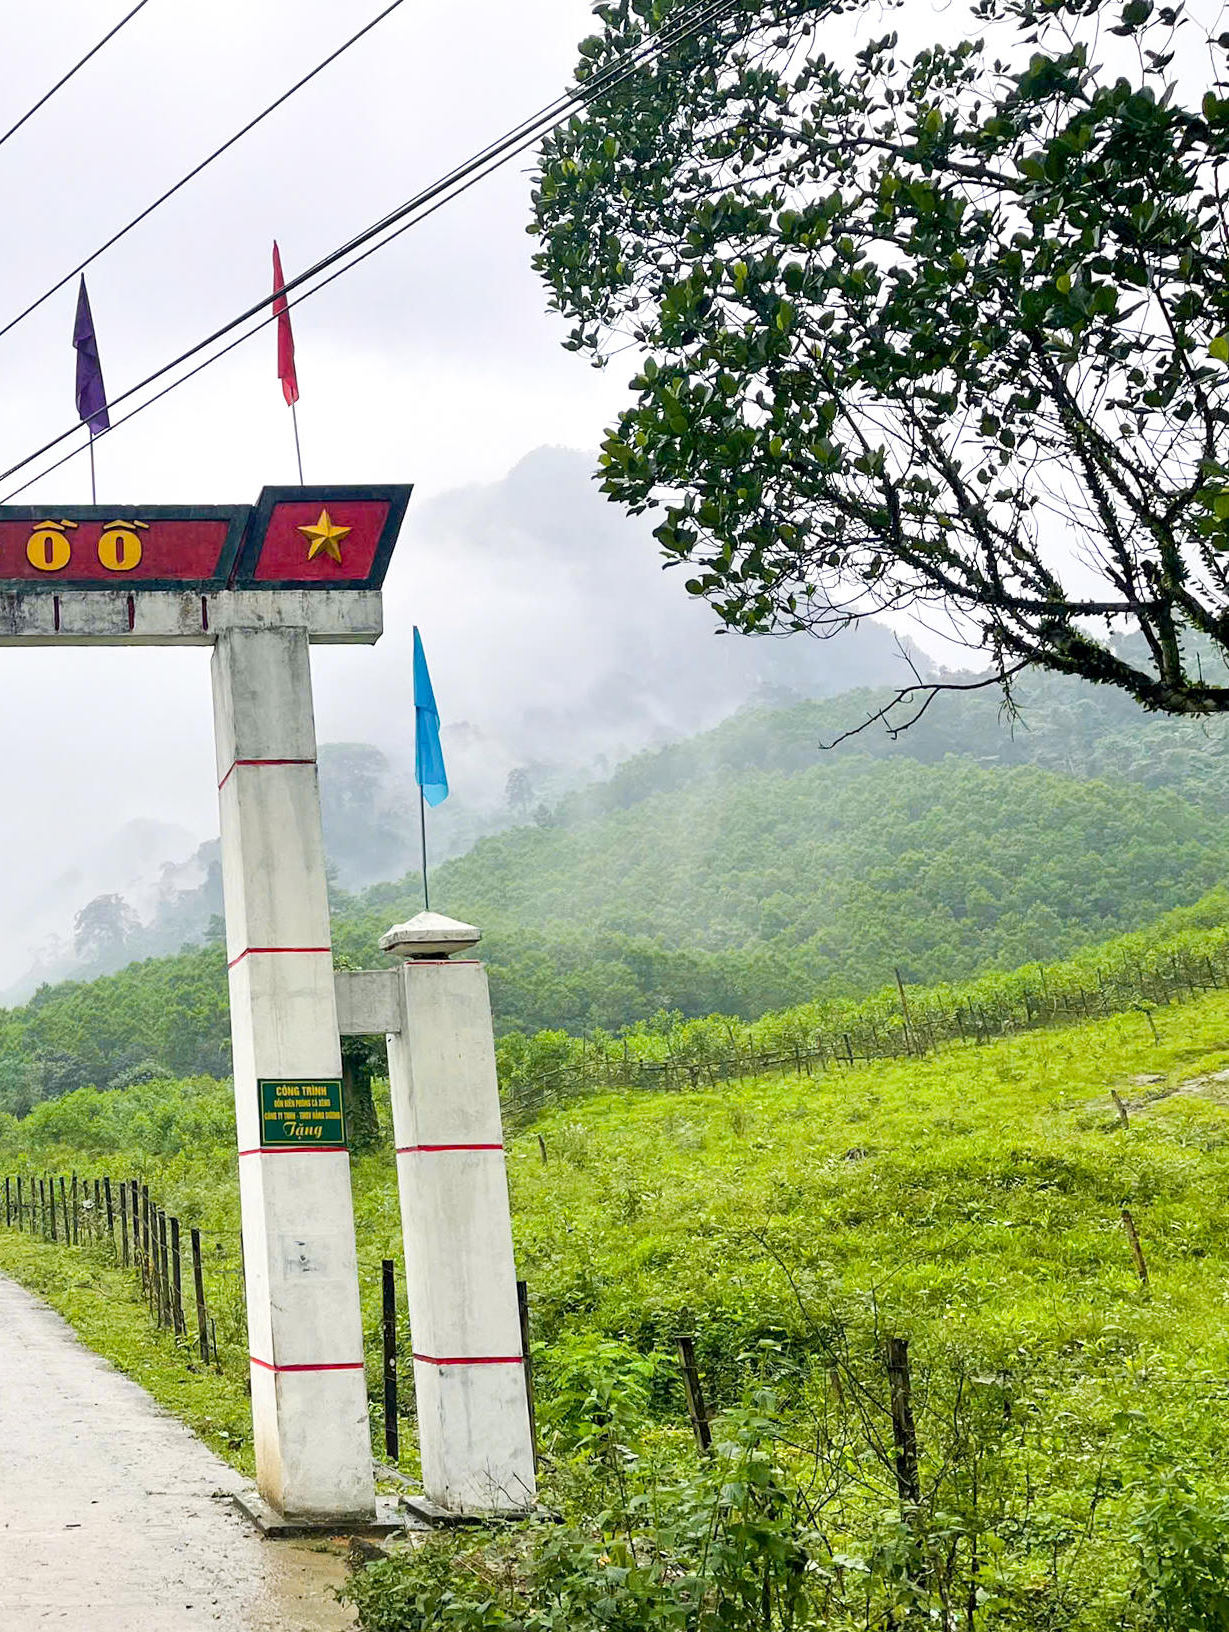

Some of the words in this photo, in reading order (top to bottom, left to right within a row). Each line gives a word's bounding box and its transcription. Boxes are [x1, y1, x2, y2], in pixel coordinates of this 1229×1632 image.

[26, 519, 79, 571] Ồ
[97, 519, 150, 571] Ồ
[276, 1084, 300, 1097] CÔNG
[301, 1084, 327, 1096] TRÌNH
[282, 1121, 323, 1140] Tặng
